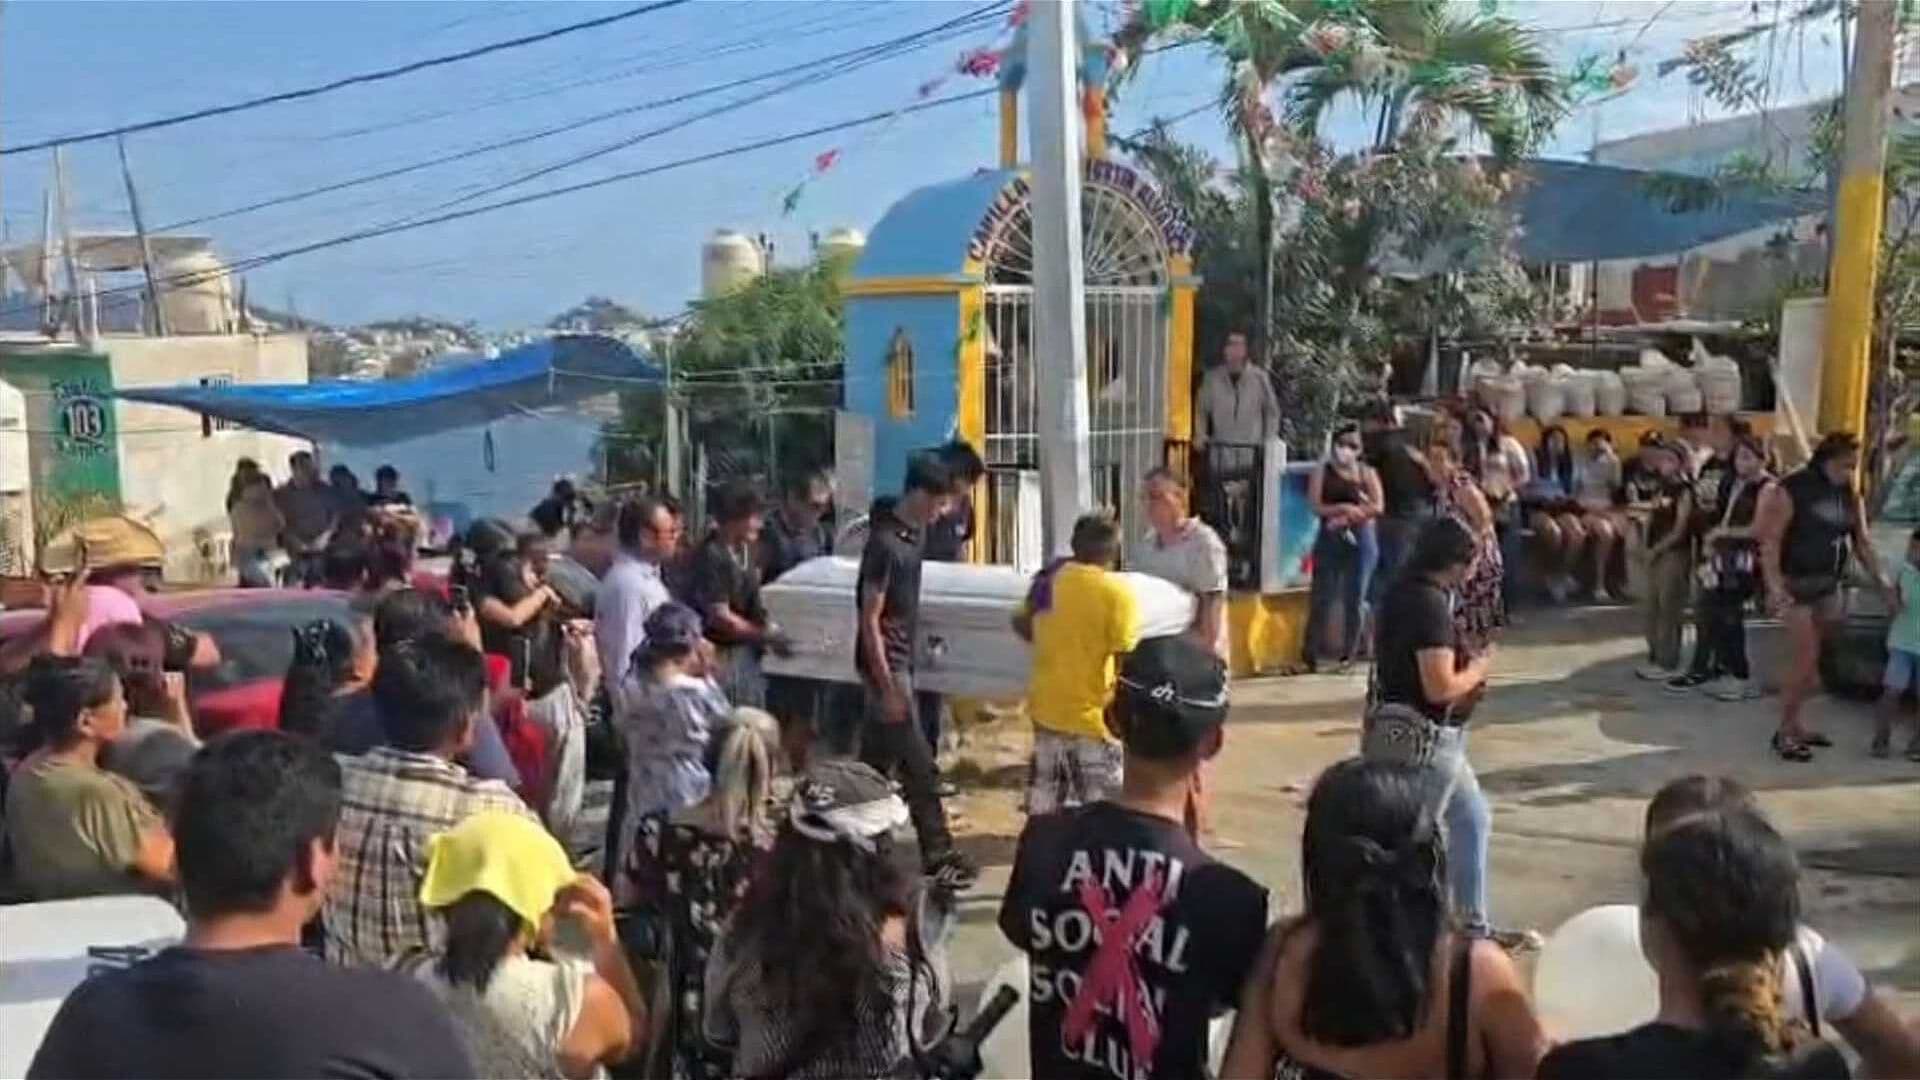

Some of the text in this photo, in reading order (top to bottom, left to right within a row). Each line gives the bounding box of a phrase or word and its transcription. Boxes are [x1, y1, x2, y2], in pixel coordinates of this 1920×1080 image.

[66, 403, 103, 438] 103
[1060, 847, 1185, 903] ANTI
[1031, 906, 1191, 972] SOAL
[1061, 1024, 1153, 1080] CLU
